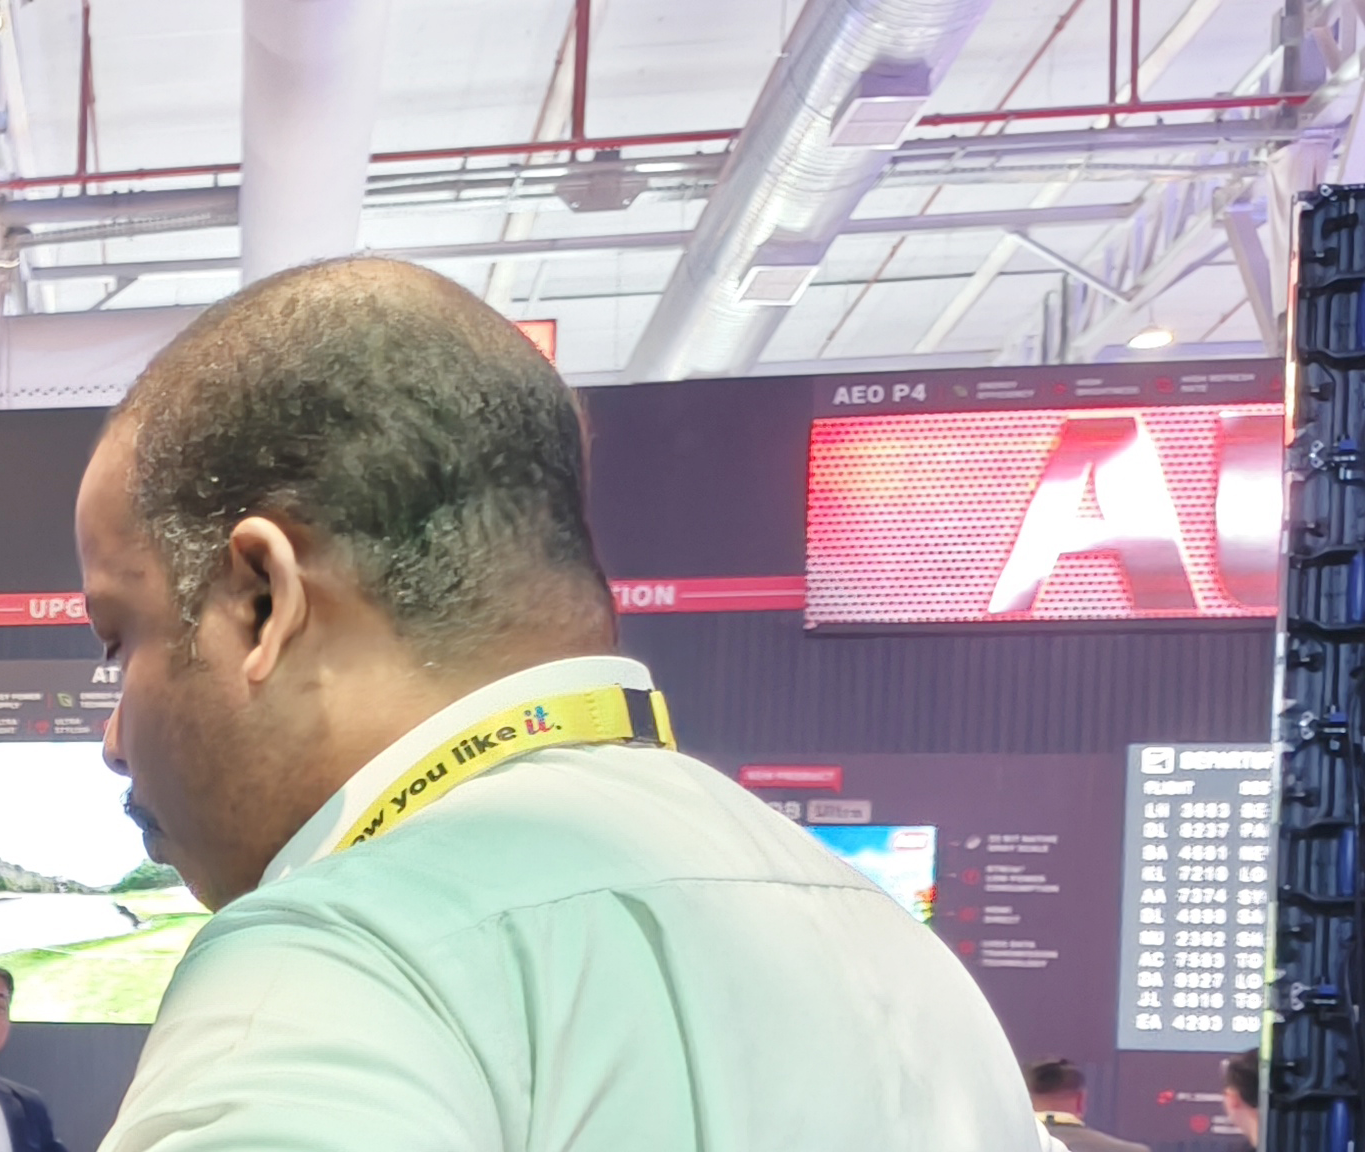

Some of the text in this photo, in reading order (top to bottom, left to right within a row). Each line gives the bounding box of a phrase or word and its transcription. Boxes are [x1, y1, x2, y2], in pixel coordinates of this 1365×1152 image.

[892, 383, 927, 402] P4
[389, 762, 448, 814] you
[451, 723, 518, 766] like
